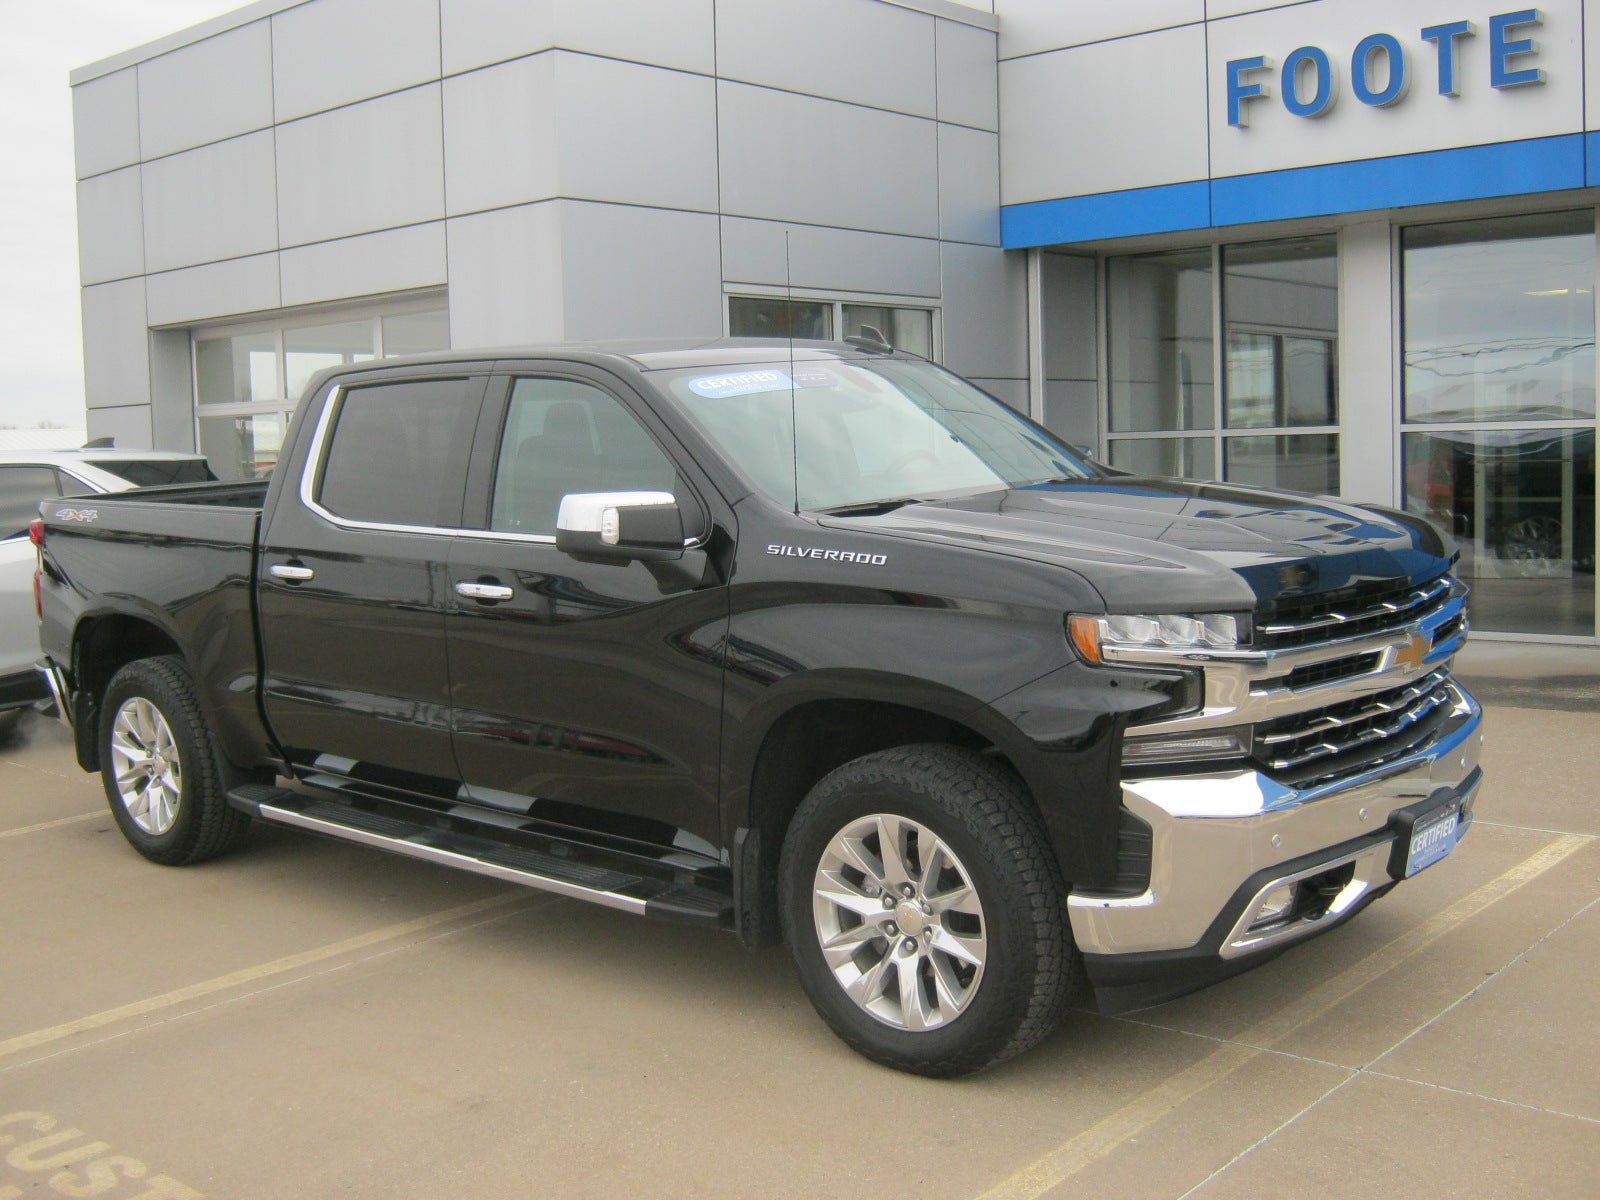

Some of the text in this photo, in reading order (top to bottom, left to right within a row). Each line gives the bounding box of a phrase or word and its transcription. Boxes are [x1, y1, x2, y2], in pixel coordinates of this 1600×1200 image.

[1226, 8, 1546, 128] FOOTE
[696, 372, 779, 390] CERTIFIED
[766, 544, 888, 566] SILVERADO
[1411, 817, 1456, 855] CERTIFIED
